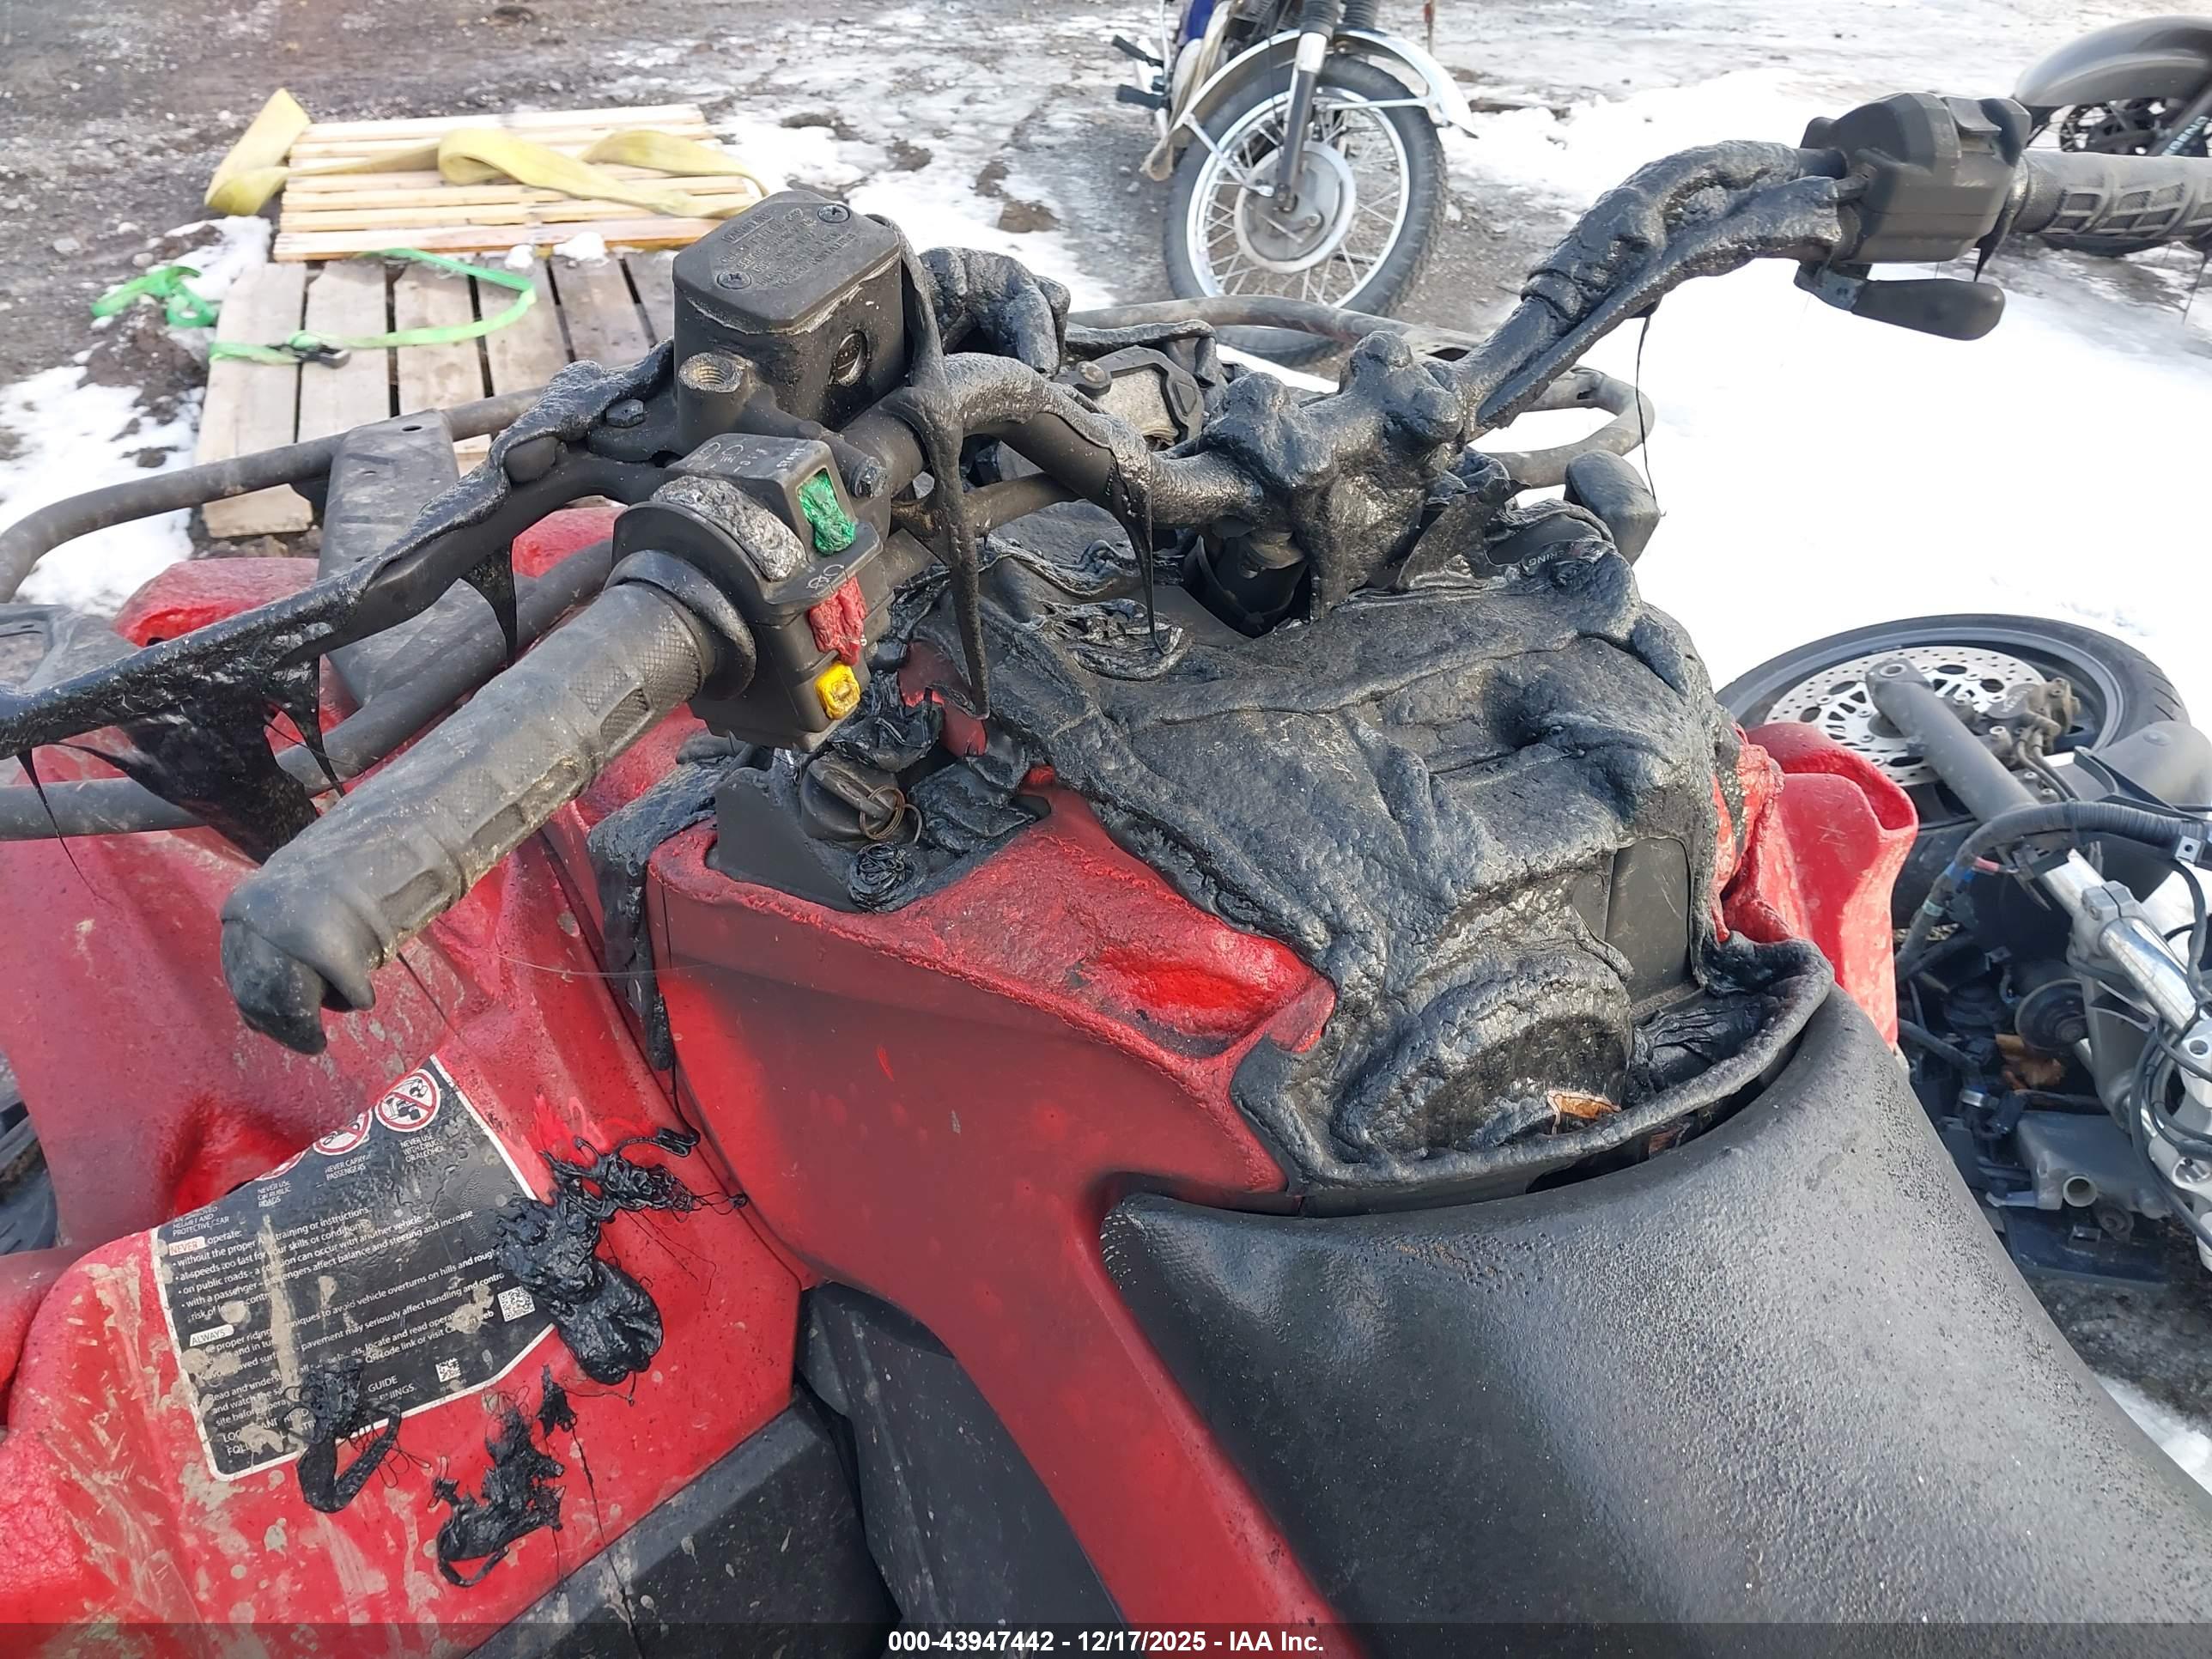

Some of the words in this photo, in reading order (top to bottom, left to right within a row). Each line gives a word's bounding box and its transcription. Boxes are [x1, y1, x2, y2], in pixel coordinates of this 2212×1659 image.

[400, 1136, 422, 1148] NEVER
[421, 1132, 434, 1142] USE
[402, 1145, 420, 1156] WITH
[419, 1138, 443, 1151] DRUGS
[404, 1154, 416, 1163] OR
[416, 1146, 447, 1159] ALCOHOL
[325, 1161, 345, 1174] NEVER
[326, 1163, 366, 1181] PASSENGERS
[258, 1182, 278, 1194] NEVER
[258, 1195, 281, 1207] ROADS
[198, 1212, 214, 1222] AND
[173, 1218, 212, 1237] PROTECTIVE
[177, 1252, 210, 1267] without
[211, 1248, 227, 1258] the
[227, 1240, 256, 1256] proper
[275, 1225, 309, 1241] training
[309, 1222, 319, 1231] or
[319, 1205, 373, 1227] instructions.
[170, 1241, 198, 1256] NEVER
[207, 1230, 242, 1246] operate:
[185, 1296, 206, 1308] with
[214, 1282, 257, 1303] passenger
[263, 1267, 312, 1288] pasengers
[313, 1257, 337, 1271] affect
[337, 1247, 371, 1263] balance
[372, 1238, 388, 1252] and
[389, 1229, 422, 1246] steering
[423, 1221, 440, 1234] and
[440, 1210, 473, 1227] increase
[190, 1263, 221, 1279] speeds
[237, 1255, 253, 1266] fast
[253, 1251, 266, 1261] for
[288, 1238, 309, 1251] skills
[310, 1236, 320, 1244] or
[183, 1285, 195, 1295] on
[196, 1278, 223, 1293] public
[224, 1270, 248, 1283] roads
[261, 1257, 296, 1273] colion
[297, 1252, 313, 1262] can
[313, 1243, 338, 1257] occur
[191, 1310, 208, 1321] risk
[207, 1305, 216, 1316] of
[246, 1292, 271, 1305] contr
[216, 1336, 245, 1353] proper
[320, 1310, 331, 1318] to
[331, 1299, 356, 1314] avoid
[356, 1290, 386, 1305] vehicle
[387, 1276, 427, 1295] overturns
[428, 1272, 440, 1280] on
[439, 1264, 457, 1276] hills
[458, 1256, 474, 1269] and
[301, 1331, 343, 1352] pavement
[344, 1323, 363, 1336] may
[364, 1310, 402, 1329] seriously
[402, 1301, 426, 1316] affect
[425, 1289, 463, 1306] handling
[463, 1280, 480, 1293] and
[479, 1273, 505, 1287] contro
[190, 1328, 226, 1346] ALWAYS
[251, 1343, 261, 1352] in
[231, 1383, 248, 1395] and
[364, 1337, 391, 1352] locate
[392, 1328, 409, 1341] and
[409, 1322, 428, 1335] read
[210, 1402, 229, 1415] and
[230, 1395, 257, 1408] watch
[256, 1391, 272, 1401] the
[379, 1346, 400, 1358] code
[400, 1339, 416, 1350] link
[416, 1336, 426, 1345] or
[427, 1328, 445, 1340] visit
[222, 1429, 243, 1443] LOC
[368, 1375, 398, 1393] GUIDE
[216, 1417, 232, 1426] site
